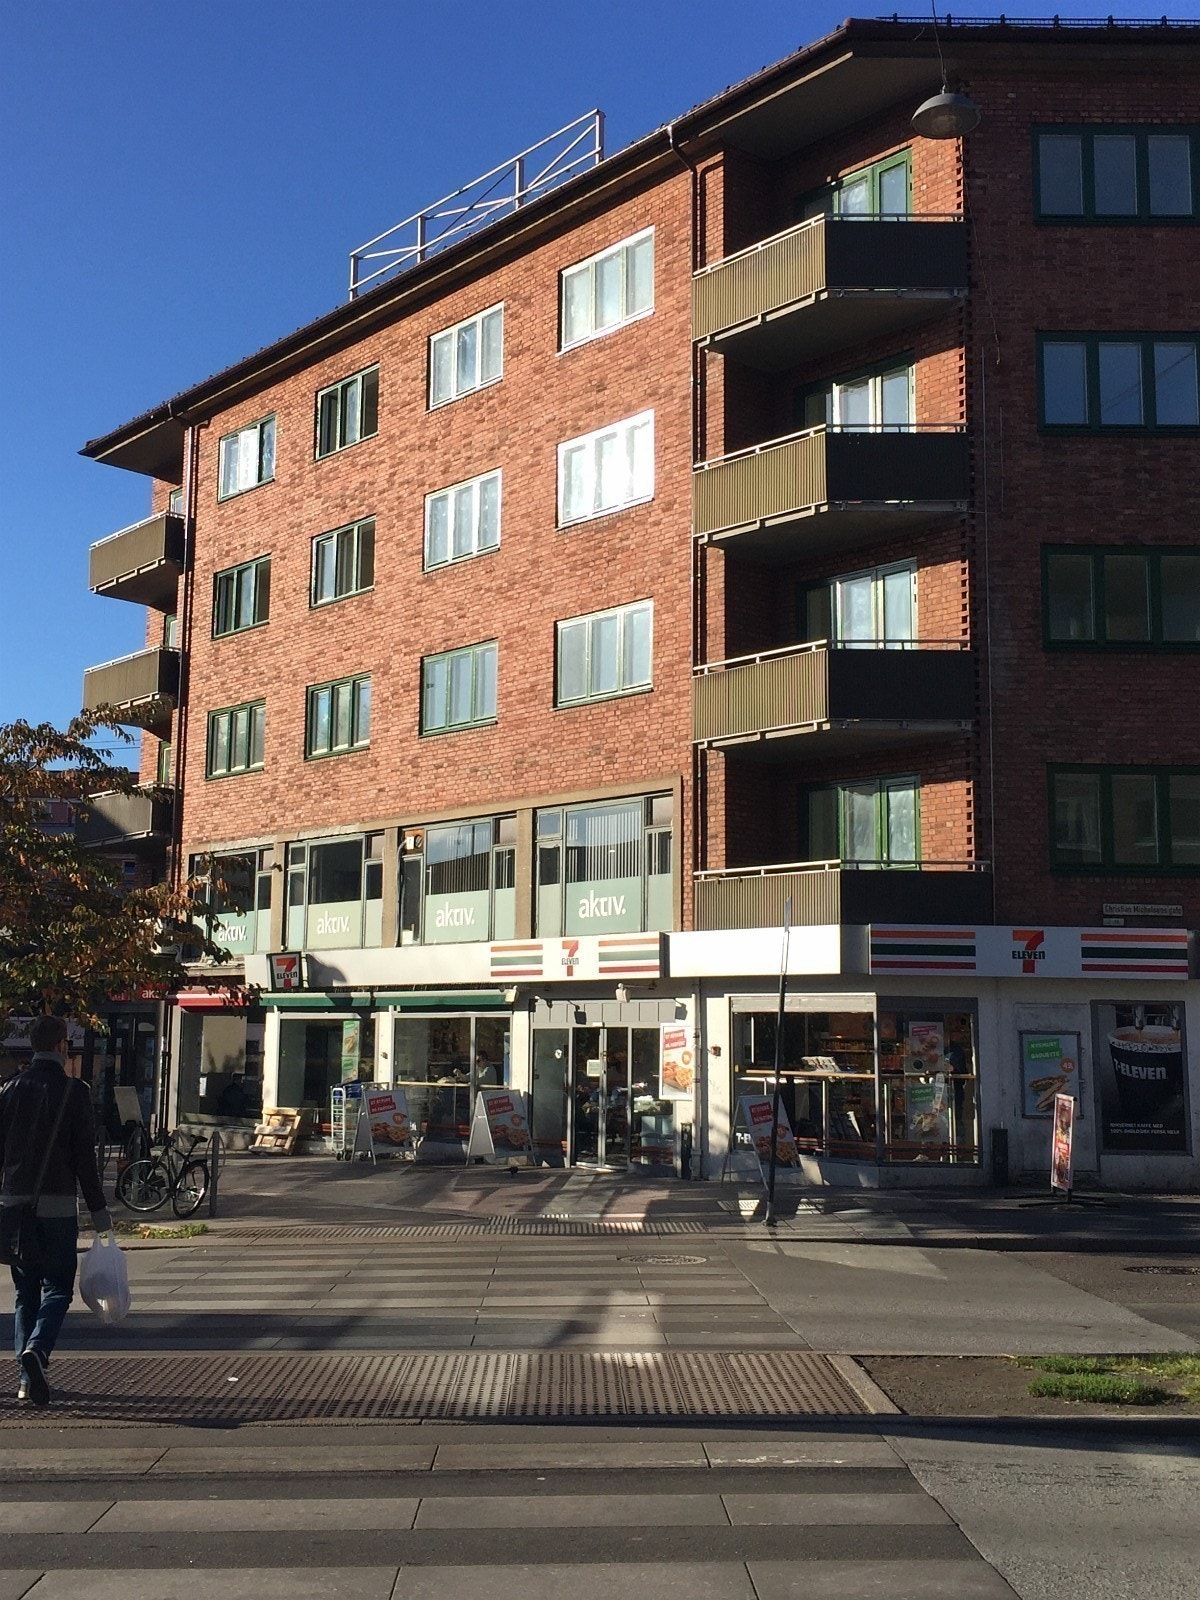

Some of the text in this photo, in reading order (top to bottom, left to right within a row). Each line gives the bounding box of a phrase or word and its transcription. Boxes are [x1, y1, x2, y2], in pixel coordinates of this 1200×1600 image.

[1105, 905, 1131, 913] Christian
[561, 940, 579, 977] 7
[1012, 929, 1045, 974] 7
[1012, 950, 1045, 959] ELEVEN
[276, 957, 297, 988] 7
